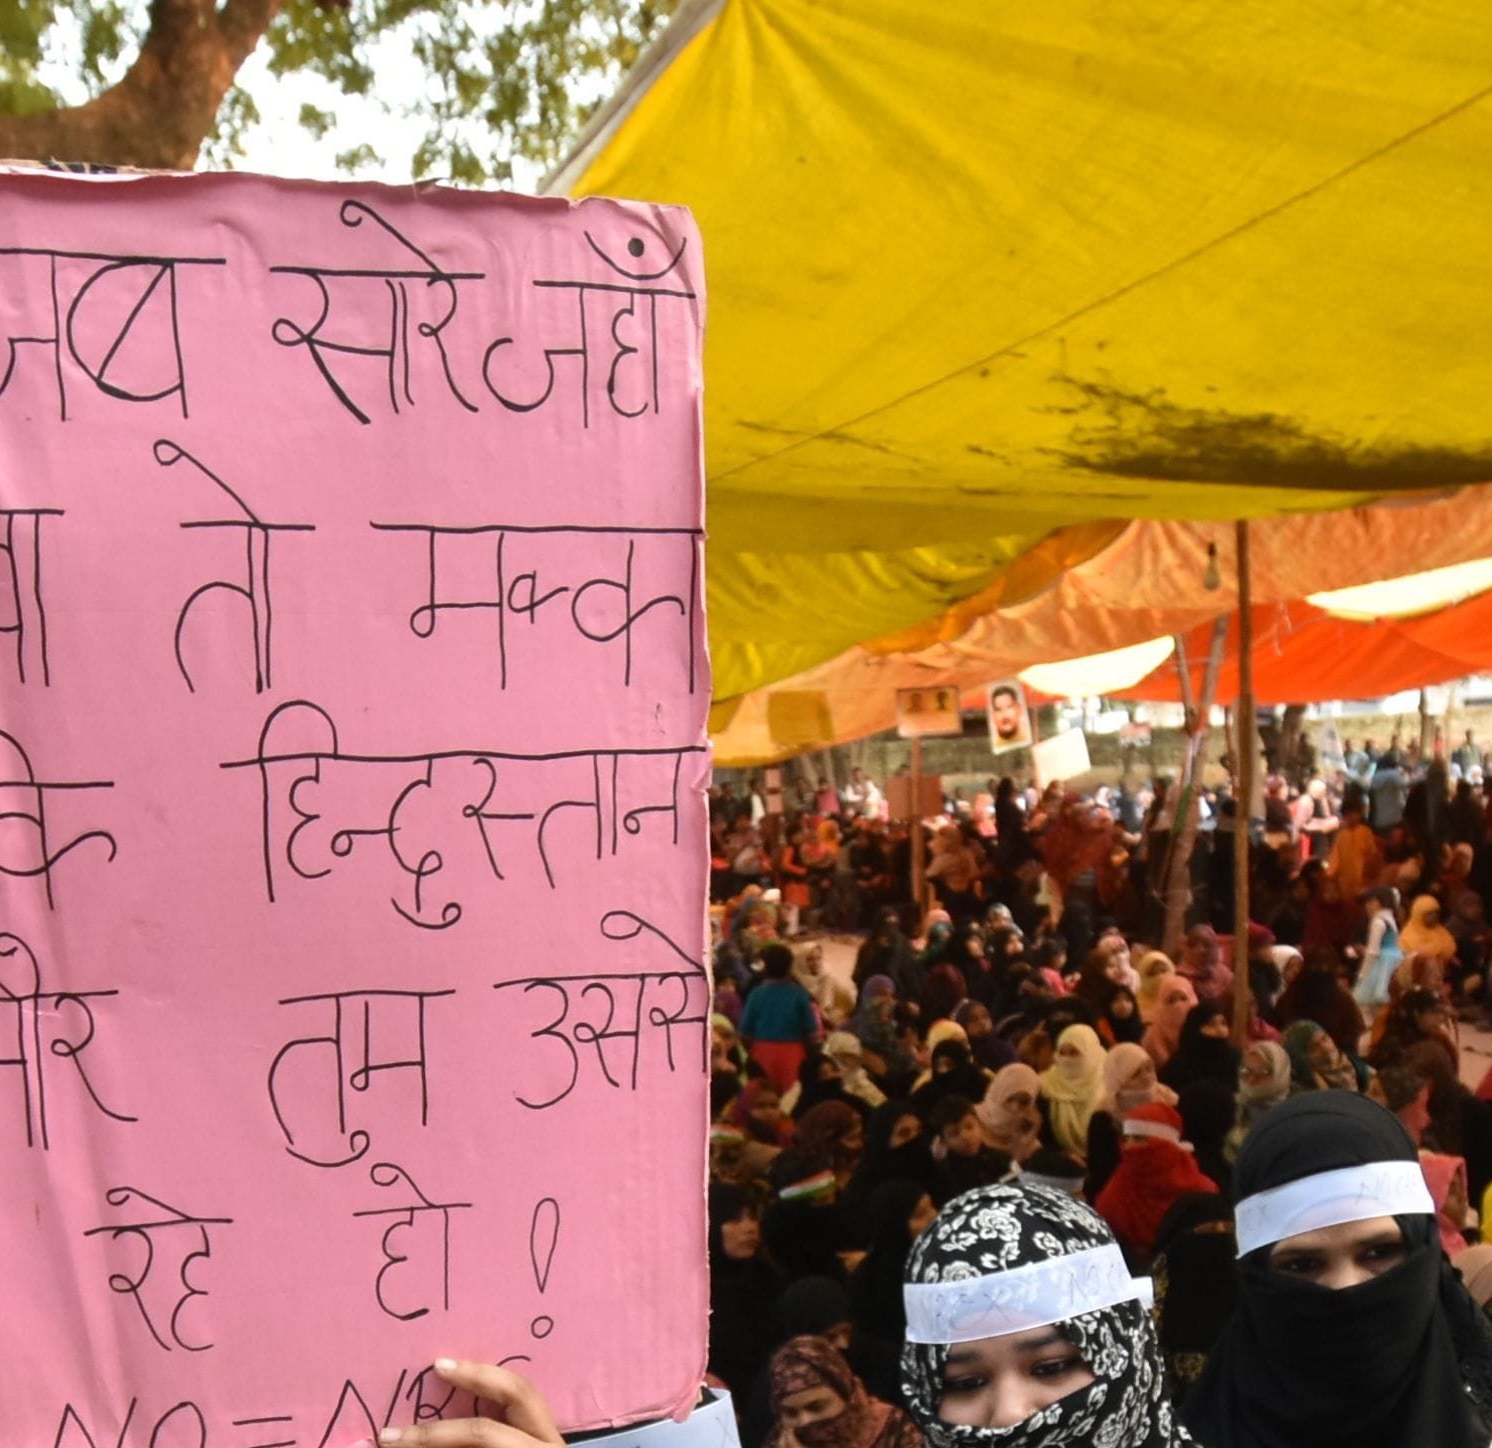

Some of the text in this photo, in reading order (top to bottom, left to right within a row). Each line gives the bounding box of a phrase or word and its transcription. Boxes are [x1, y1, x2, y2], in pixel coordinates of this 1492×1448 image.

[270, 199, 486, 425] सारे
[152, 439, 317, 695] तो
[268, 989, 457, 1168] तुम
[84, 1187, 234, 1352] रहे
[353, 1163, 473, 1322] हो
